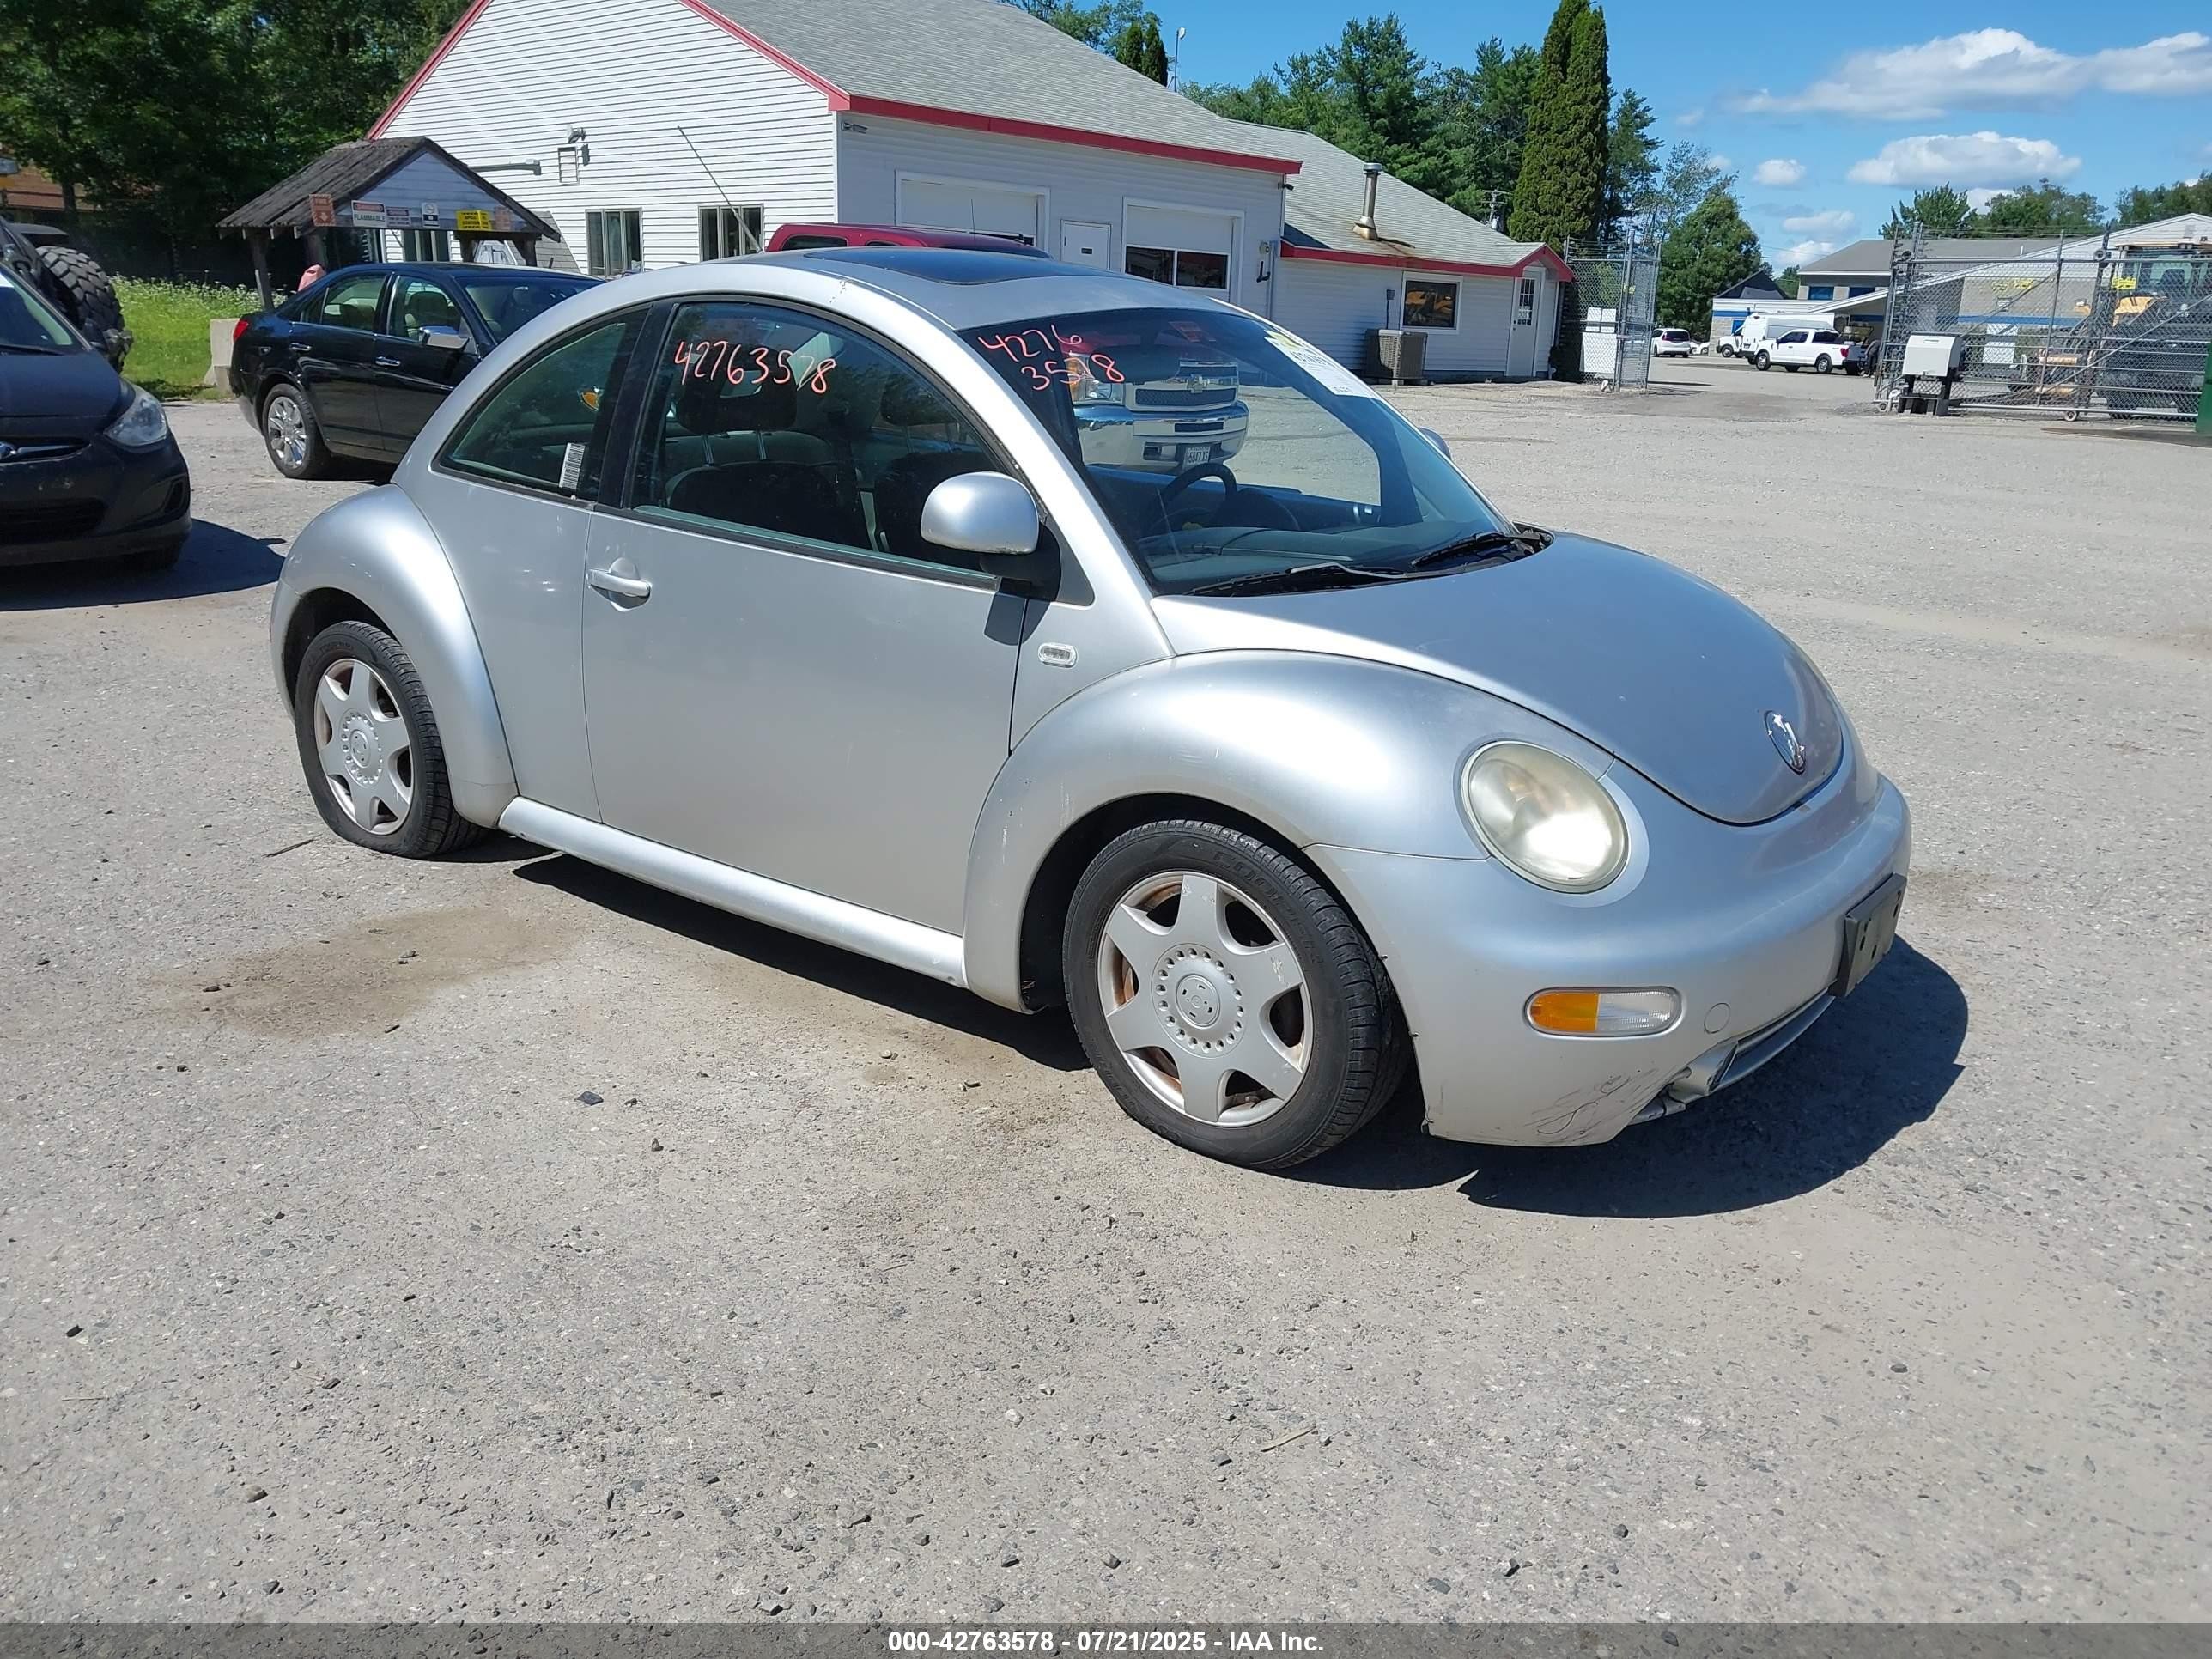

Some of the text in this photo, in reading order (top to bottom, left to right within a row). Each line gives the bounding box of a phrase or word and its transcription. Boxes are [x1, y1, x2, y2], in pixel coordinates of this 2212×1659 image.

[354, 213, 386, 222] FLAMMABLE
[977, 324, 1084, 362] 4276
[674, 341, 837, 394] 42763578
[1020, 351, 1127, 391] 3578
